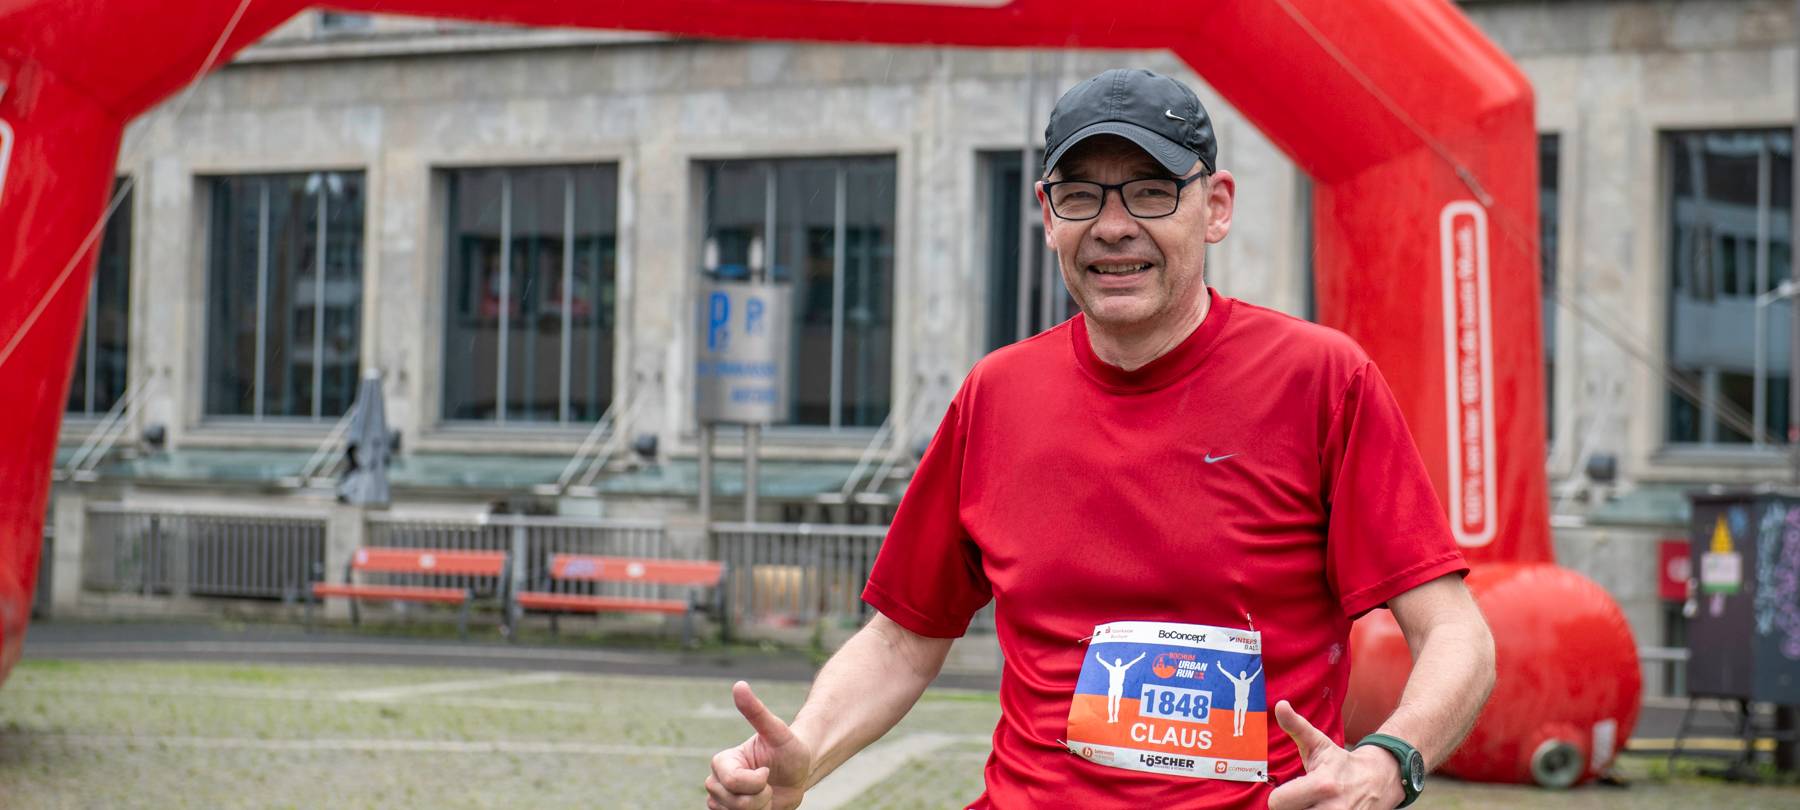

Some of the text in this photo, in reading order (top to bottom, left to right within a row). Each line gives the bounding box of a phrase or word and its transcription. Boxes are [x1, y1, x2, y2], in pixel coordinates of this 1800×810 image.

[1158, 629, 1206, 643] BoConcept
[1178, 660, 1208, 672] URBAN
[1175, 668, 1194, 679] RUN
[1143, 689, 1209, 719] 1848
[1130, 722, 1213, 750] CLAUS
[1139, 754, 1195, 768] LÖSCHER
